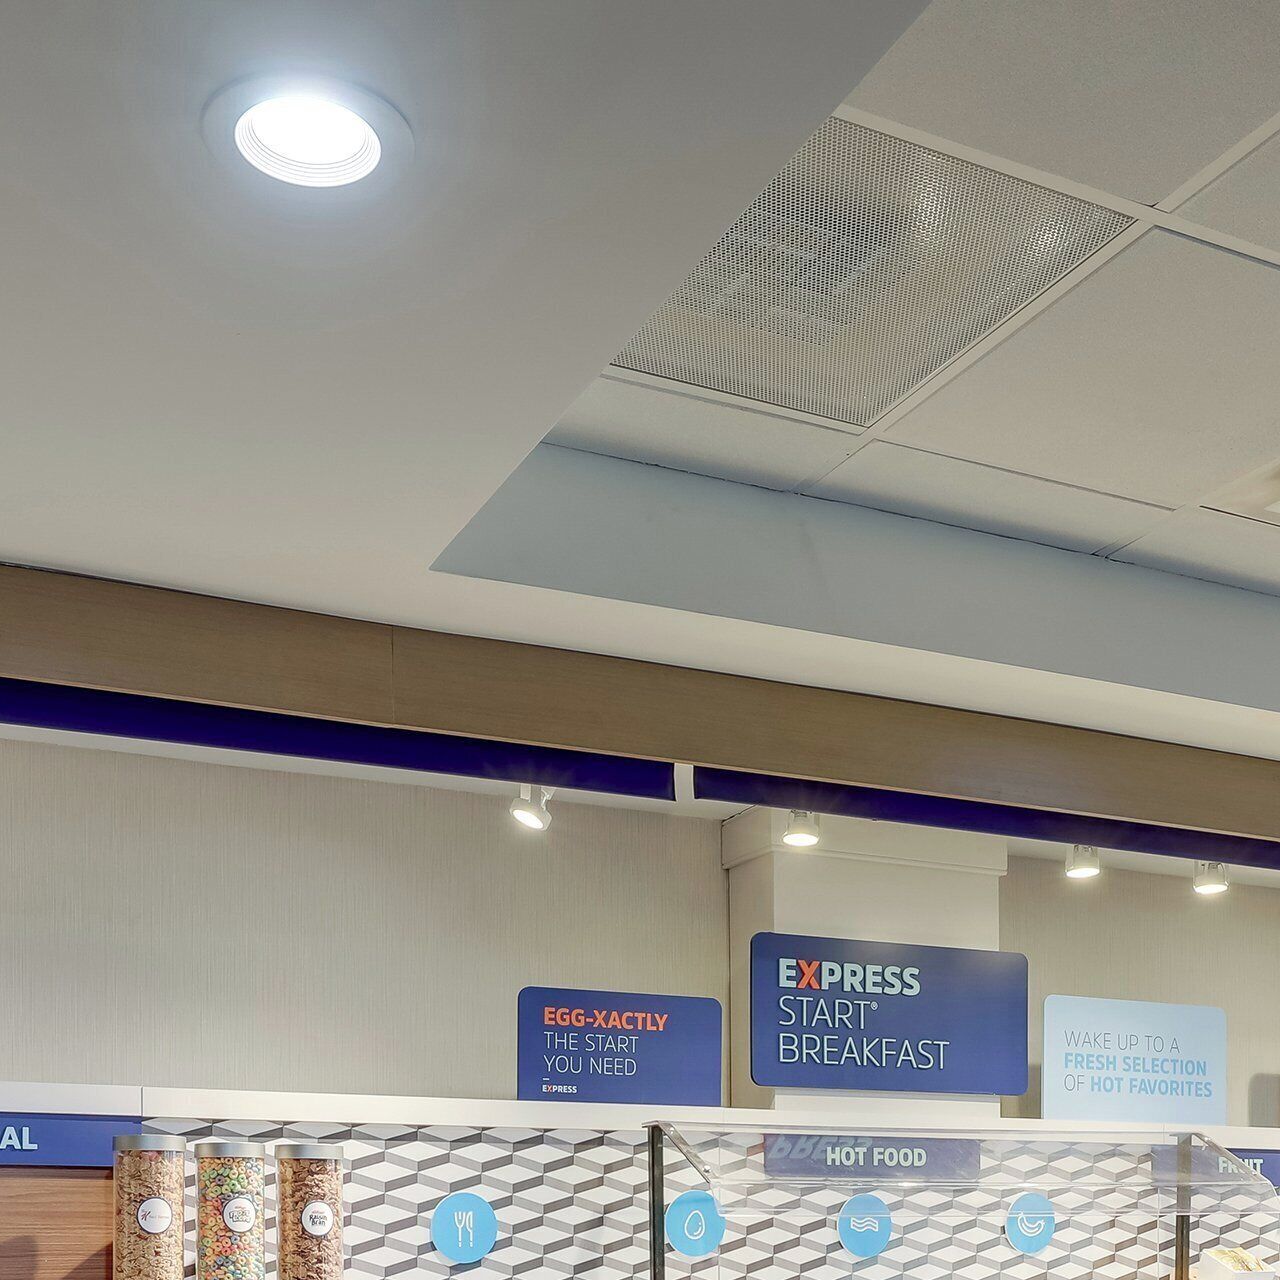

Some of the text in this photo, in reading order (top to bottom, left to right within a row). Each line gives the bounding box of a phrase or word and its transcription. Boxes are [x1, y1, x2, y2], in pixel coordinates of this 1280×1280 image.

[778, 957, 921, 996] EXPRESS
[543, 1006, 669, 1031] EGG-XACTLY
[543, 1031, 639, 1053] THE START
[779, 1032, 950, 1070] BREAKFAST
[1064, 1029, 1180, 1054] WAKE UP TO A
[543, 1054, 637, 1076] YOU NEED
[1064, 1052, 1207, 1077] FRESH SELECTION
[542, 1084, 578, 1094] EXPRESS
[1064, 1074, 1213, 1098] OF HOT FAVORITES
[826, 1146, 868, 1166] HOT
[873, 1147, 927, 1167] FOOD
